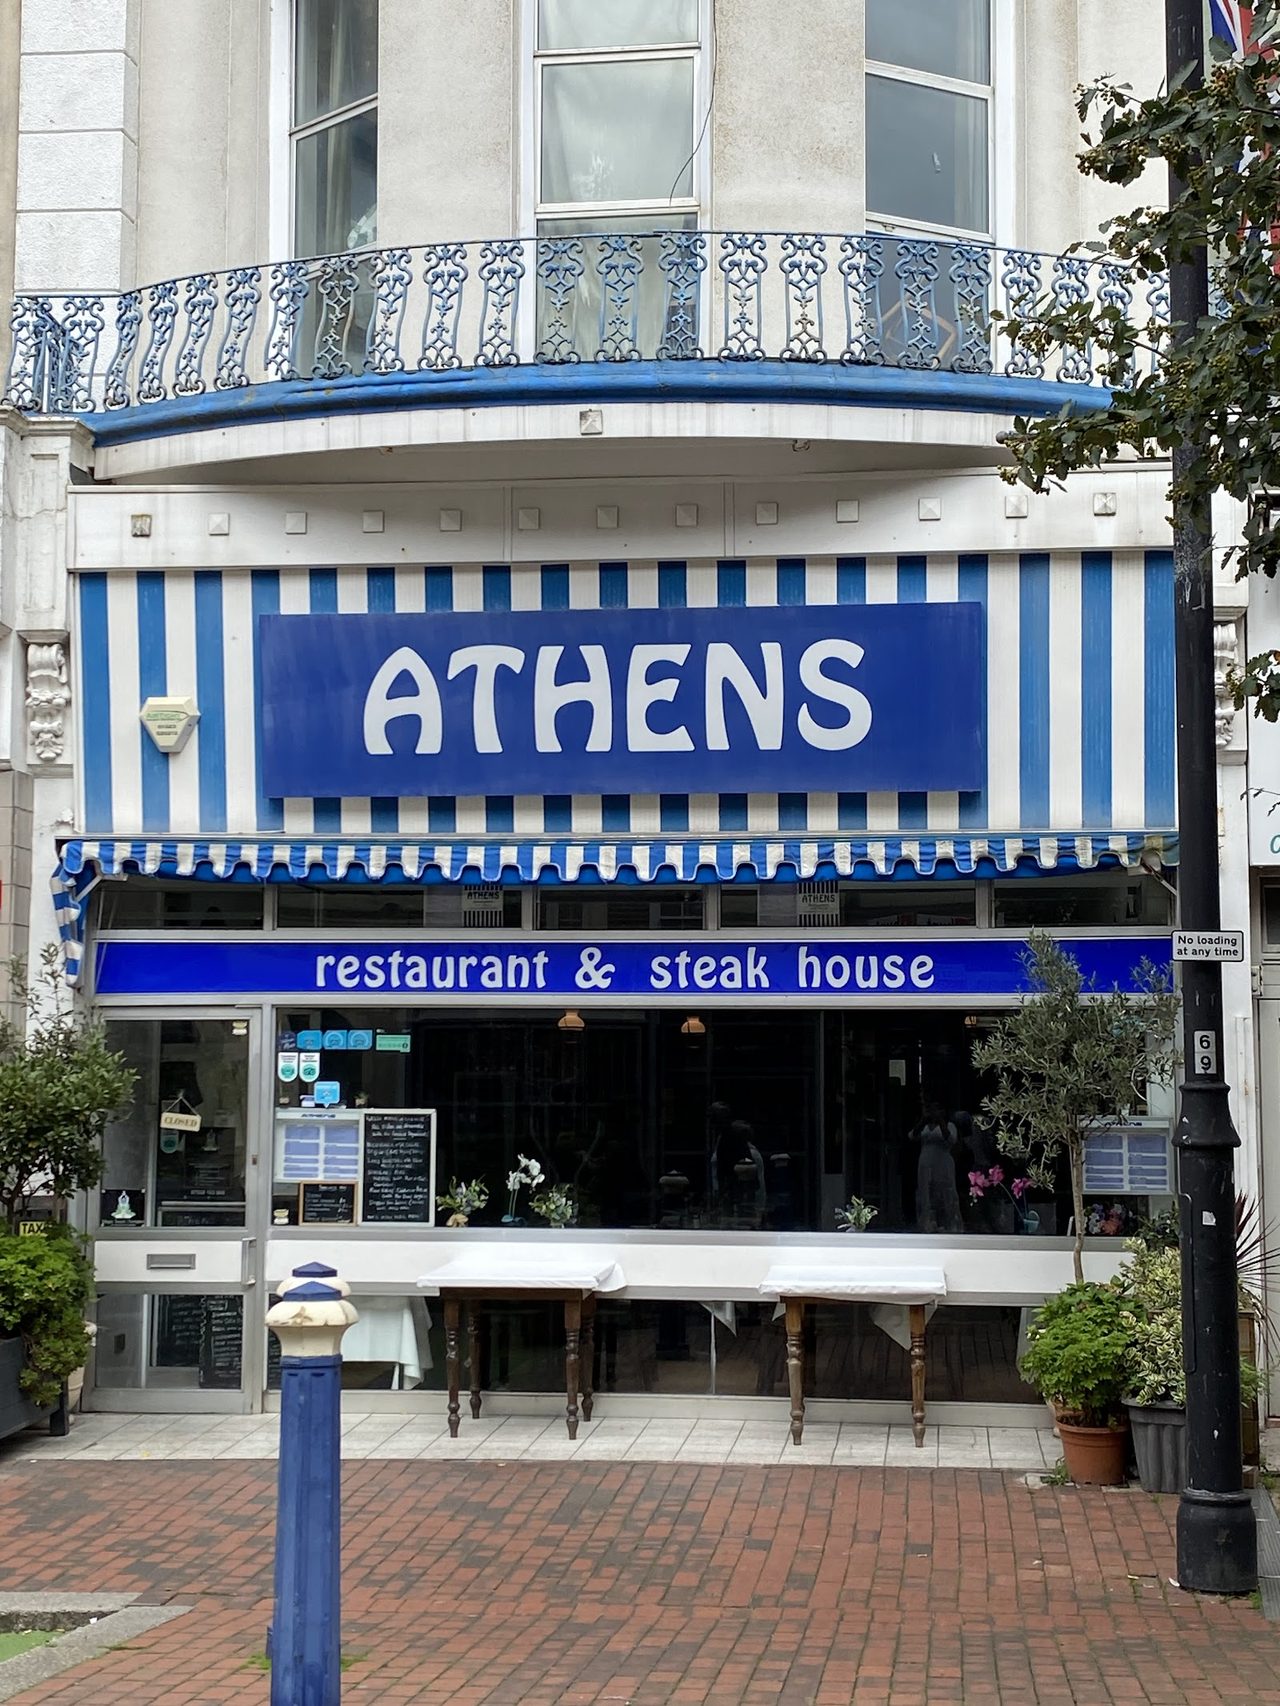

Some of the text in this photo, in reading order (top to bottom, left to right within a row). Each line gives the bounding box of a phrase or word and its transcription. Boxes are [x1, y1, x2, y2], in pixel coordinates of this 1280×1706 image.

[363, 638, 873, 755] ATHENS
[466, 890, 501, 901] ATHENS
[801, 893, 836, 904] ATHENS
[1178, 935, 1238, 947] No loading
[1176, 946, 1239, 958] at any time
[315, 946, 936, 990] restaurant & steak house
[163, 1115, 198, 1128] CLOSED
[21, 1222, 45, 1234] TAX
